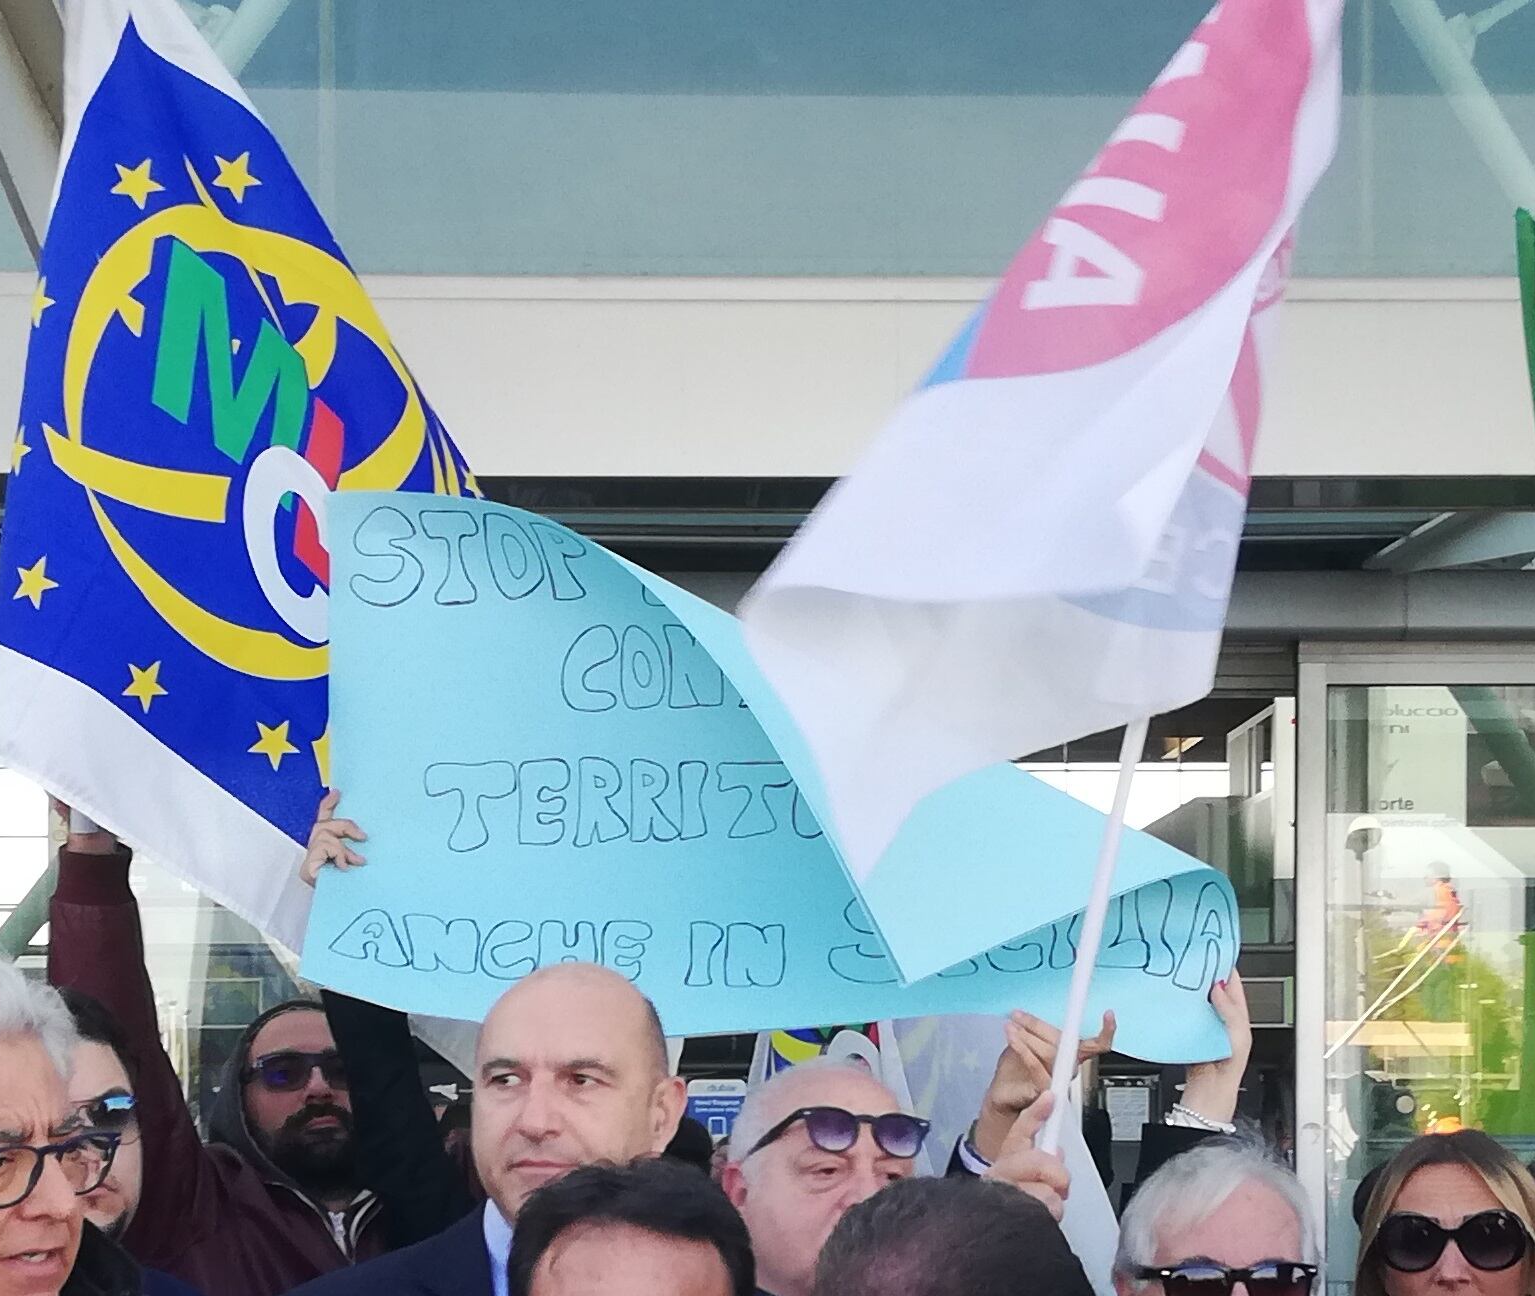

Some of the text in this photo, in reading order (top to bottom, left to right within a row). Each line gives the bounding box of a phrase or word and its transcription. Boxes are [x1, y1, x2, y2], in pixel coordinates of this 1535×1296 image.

[349, 505, 587, 607] STOP
[561, 623, 750, 712] CON
[683, 921, 785, 988] IN
